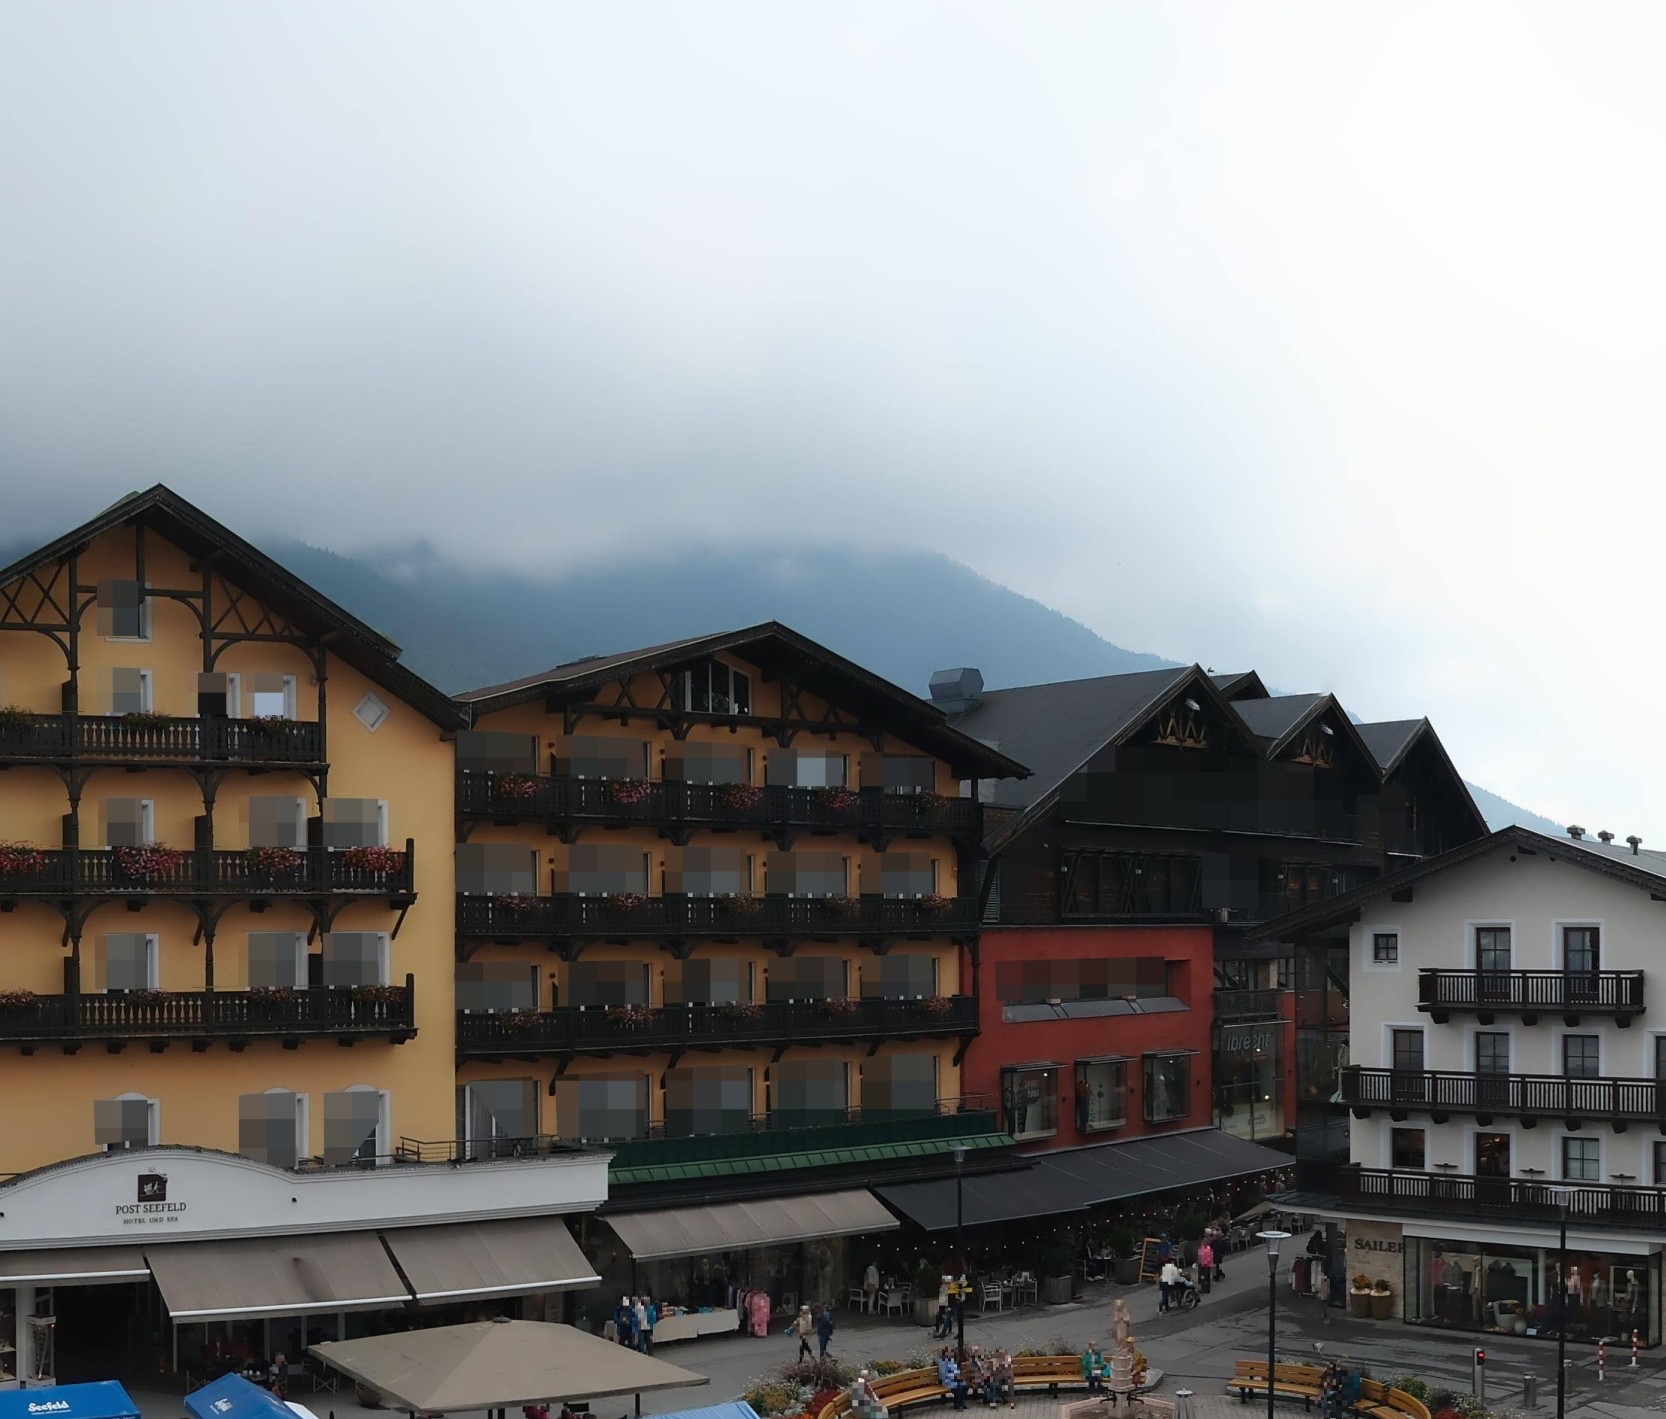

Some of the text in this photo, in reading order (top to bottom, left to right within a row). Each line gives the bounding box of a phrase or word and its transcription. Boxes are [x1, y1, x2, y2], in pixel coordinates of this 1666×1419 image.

[116, 1202, 187, 1215] POST SEEFELD
[27, 1399, 70, 1412] Seefeld
